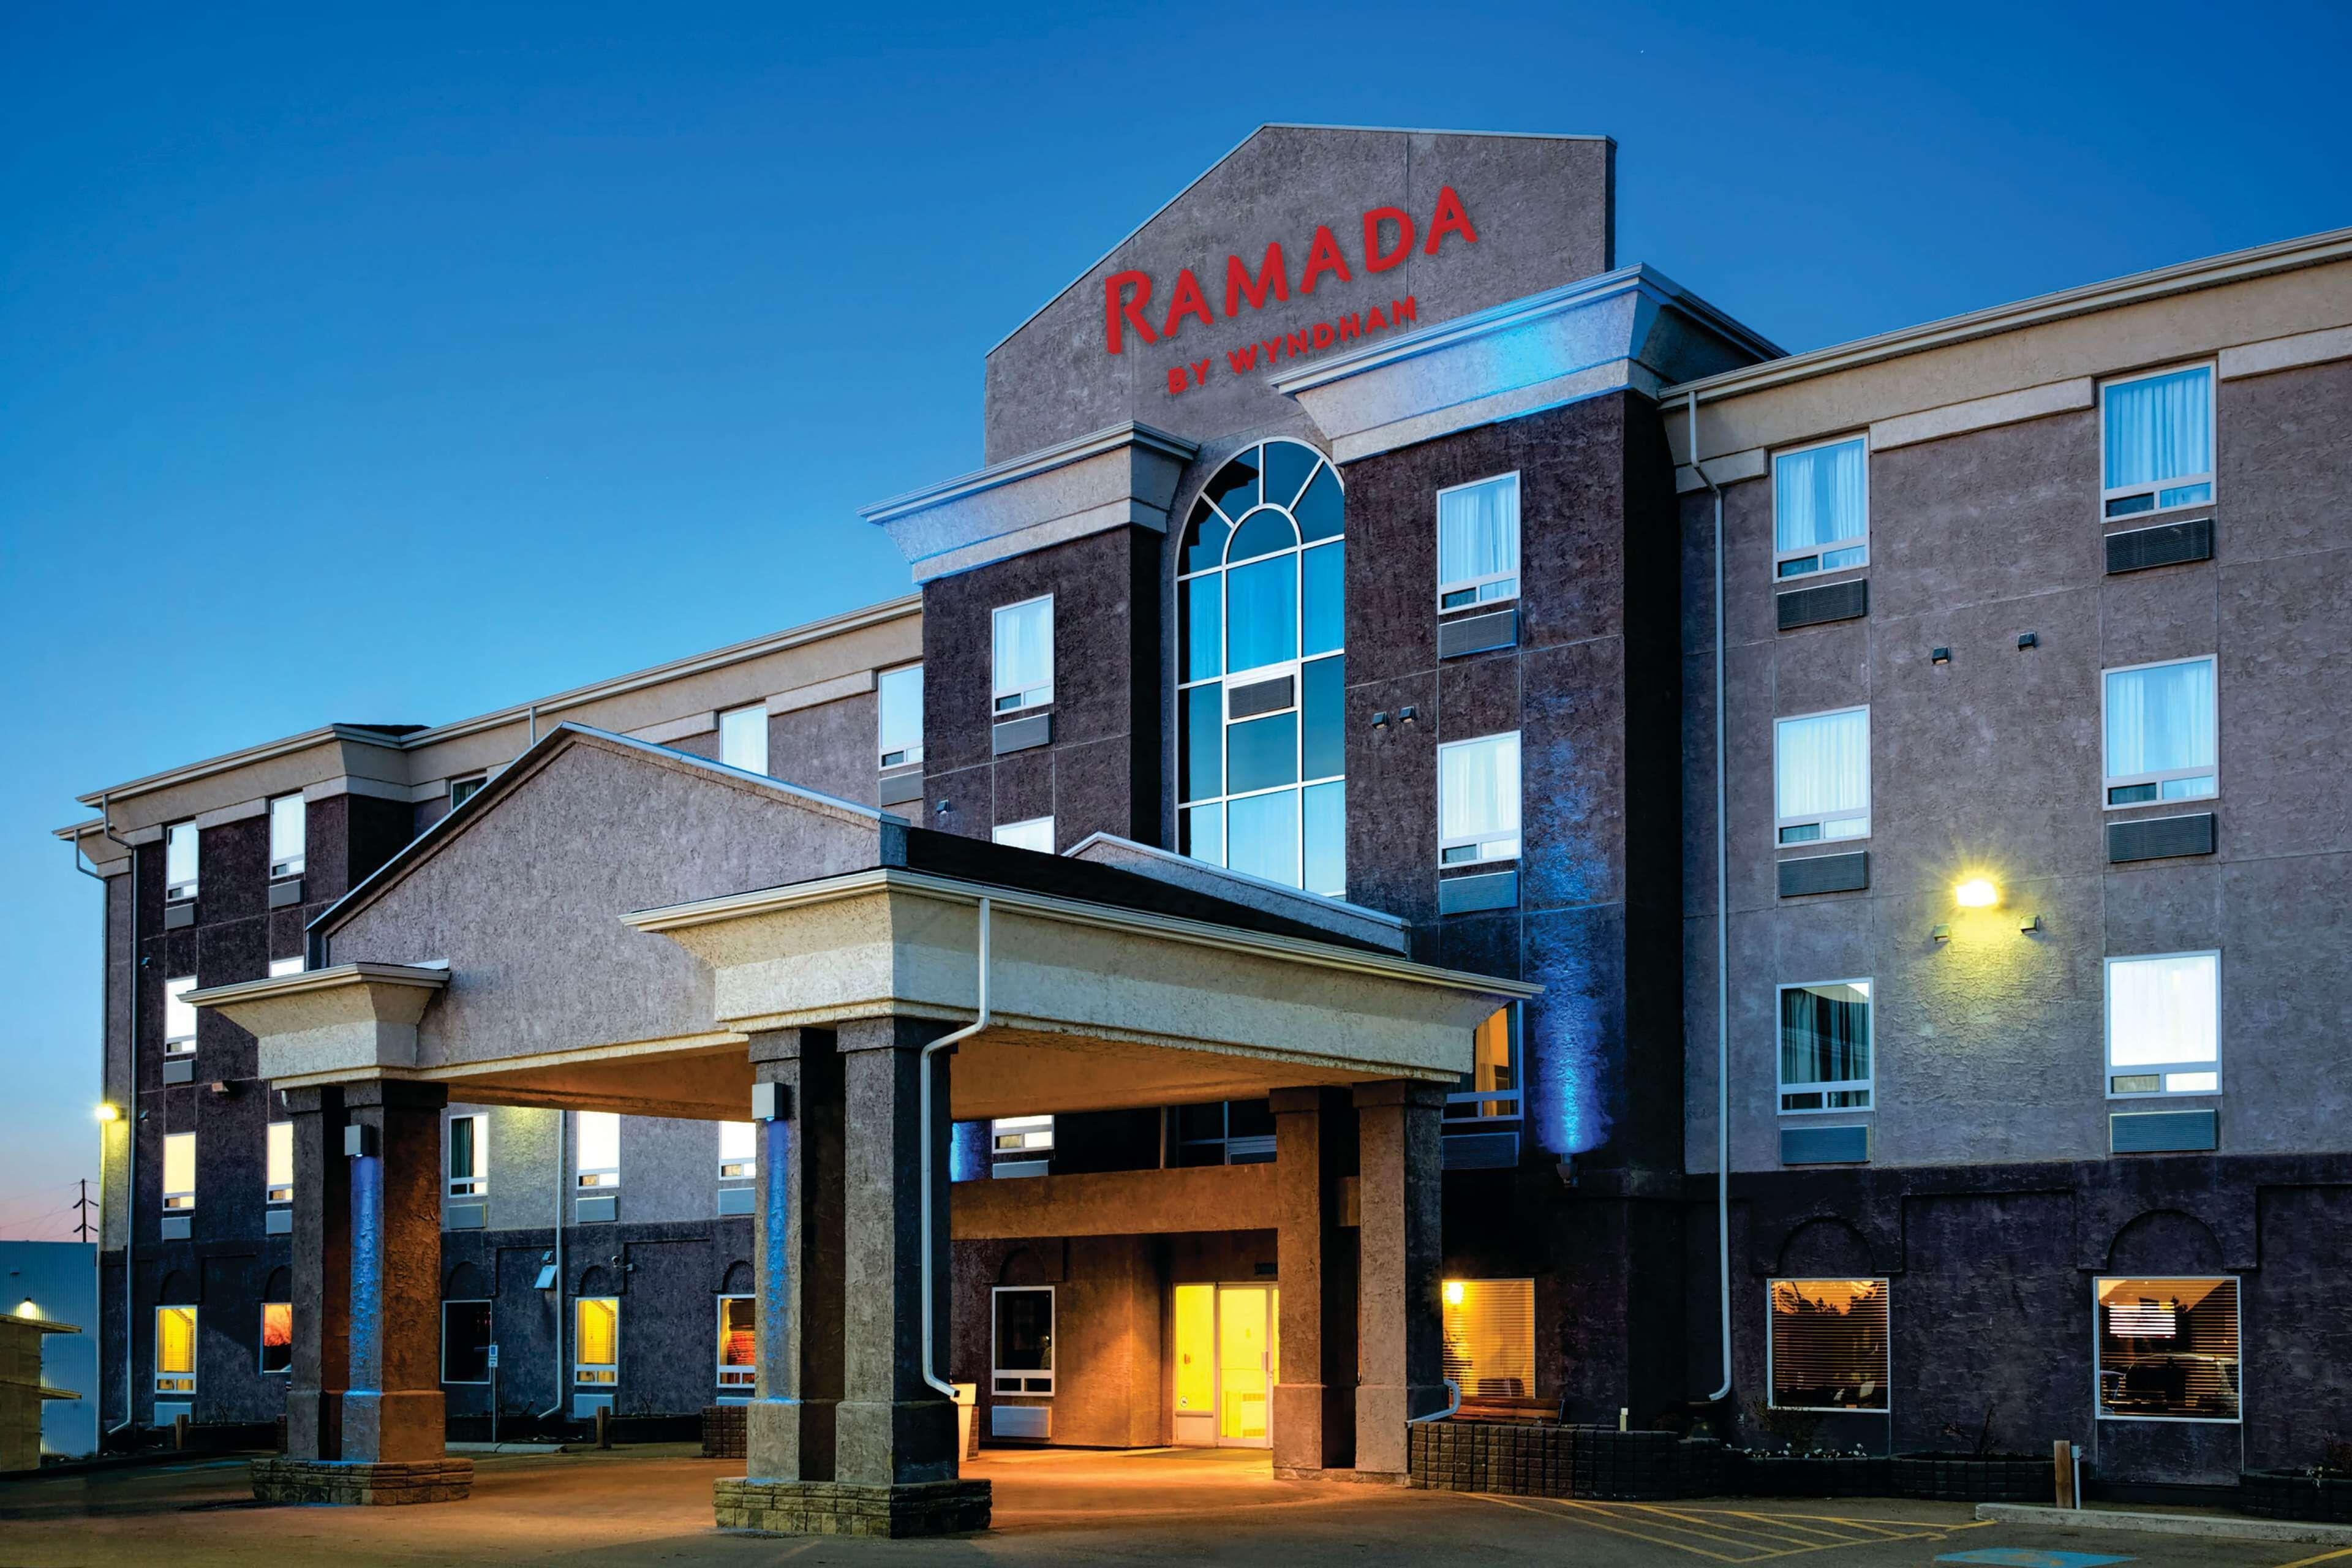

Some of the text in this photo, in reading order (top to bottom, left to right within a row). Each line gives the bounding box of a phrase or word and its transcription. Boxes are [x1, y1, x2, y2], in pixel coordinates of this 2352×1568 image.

[1104, 185, 1479, 355] RAMADA
[1167, 295, 1417, 394] BY WYNDHAM
